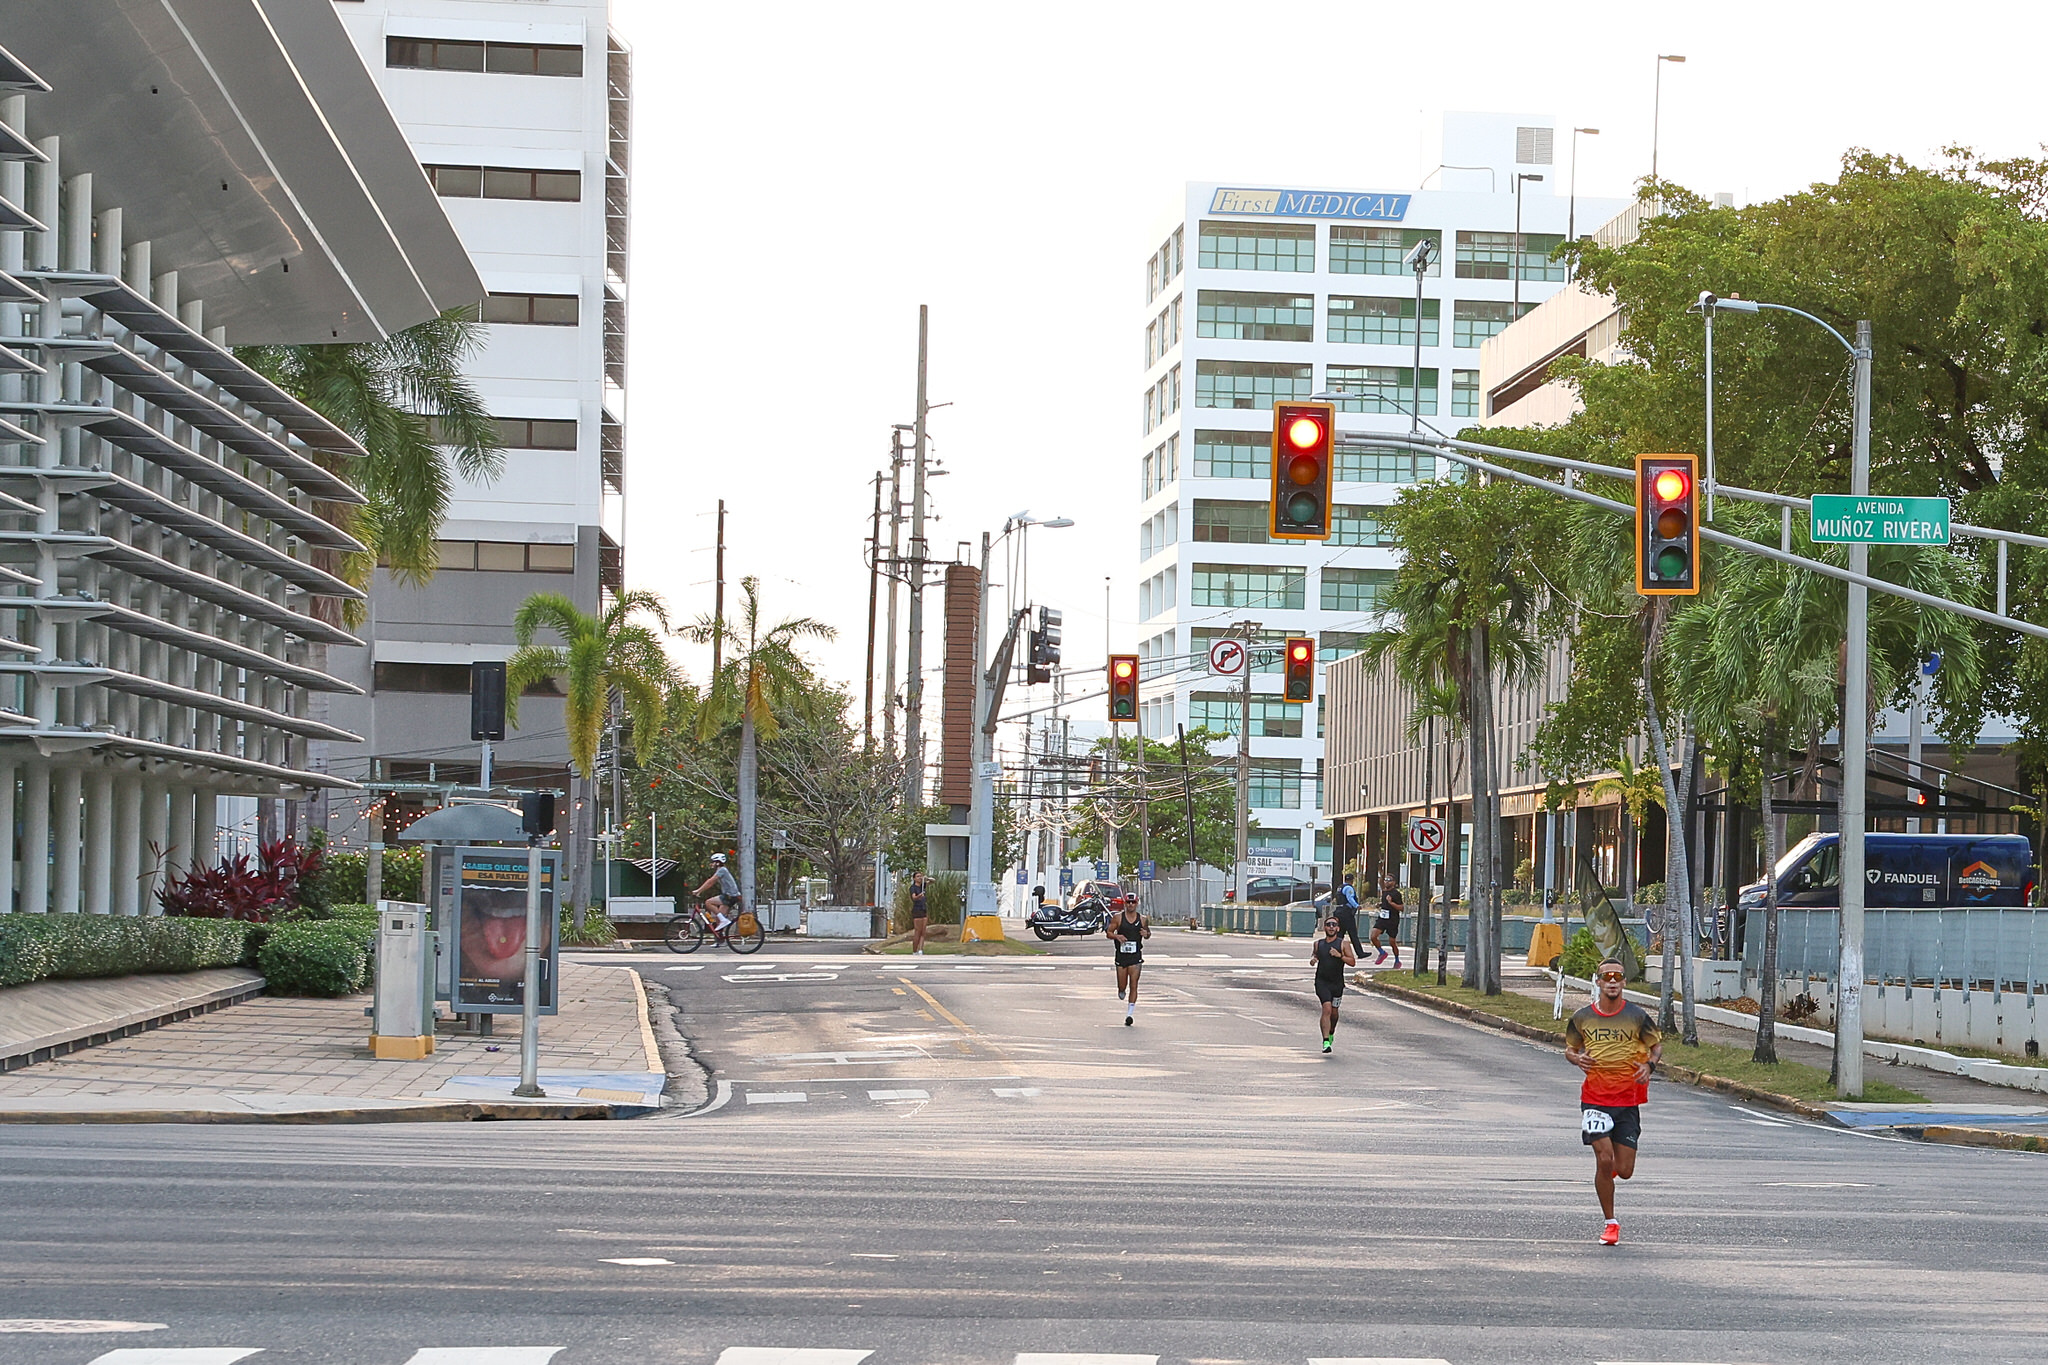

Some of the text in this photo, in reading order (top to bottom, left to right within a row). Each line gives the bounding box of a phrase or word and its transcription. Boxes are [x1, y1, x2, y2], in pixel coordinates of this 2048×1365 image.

[1217, 191, 1401, 218] First MEDICAL
[1856, 502, 1904, 514] AVENIDA
[1817, 515, 1943, 539] MUÑOZ RIVERA
[1247, 857, 1256, 866] OR
[1257, 858, 1272, 867] SALE
[494, 864, 511, 872] QUE
[512, 864, 551, 873] CONNE
[1884, 873, 1941, 885] FANDUEL
[1587, 1120, 1605, 1131] 171
